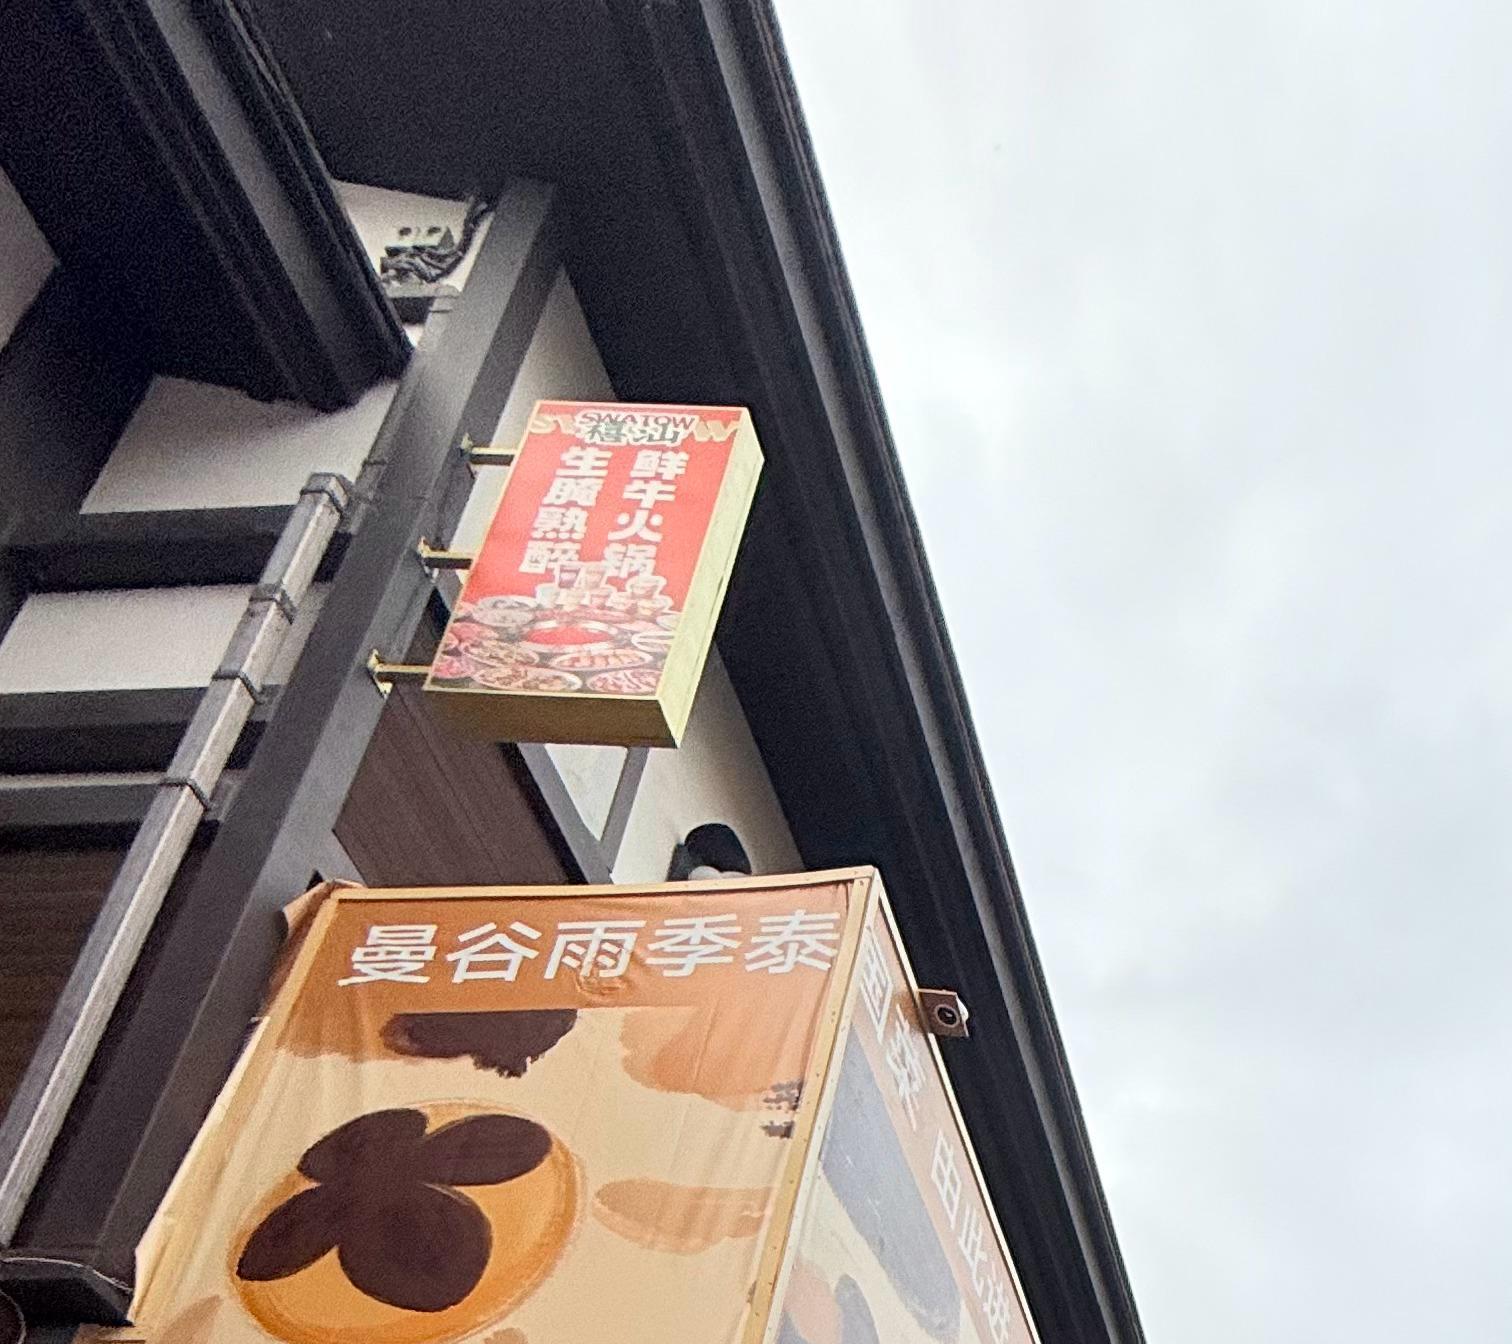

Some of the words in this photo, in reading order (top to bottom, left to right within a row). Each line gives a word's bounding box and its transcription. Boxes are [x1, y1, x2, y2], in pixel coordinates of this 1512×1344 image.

[579, 411, 695, 429] SWATOW
[338, 909, 842, 987] 曼谷雨季泰
